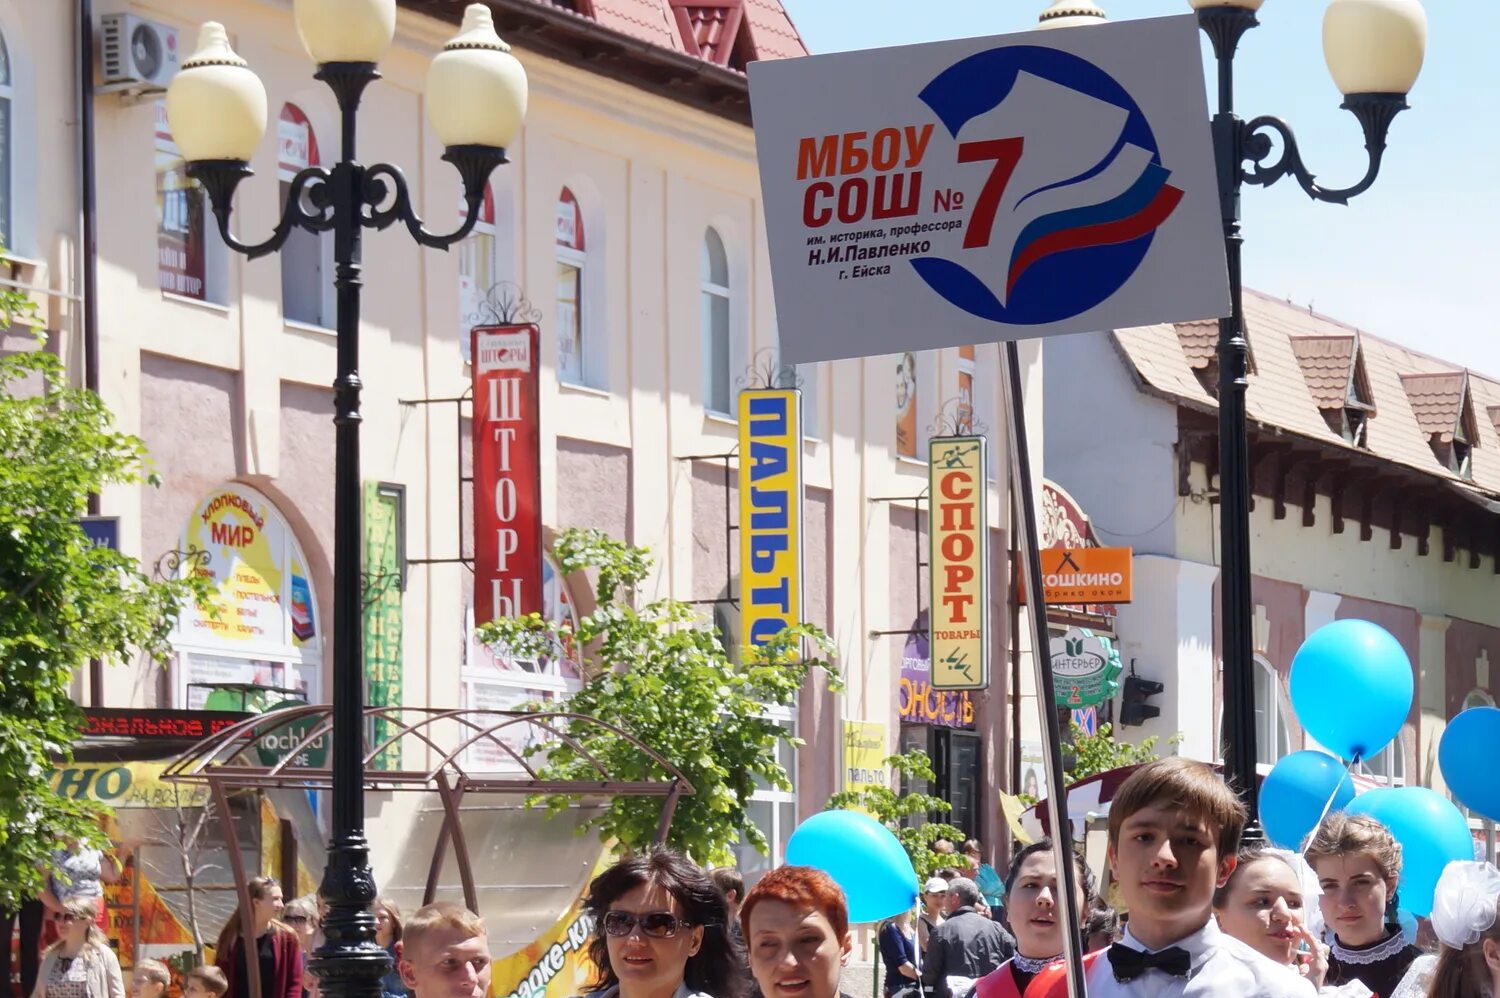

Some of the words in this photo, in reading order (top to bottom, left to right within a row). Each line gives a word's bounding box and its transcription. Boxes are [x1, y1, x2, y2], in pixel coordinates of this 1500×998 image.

[796, 124, 935, 180] МБОУ
[803, 171, 922, 228] СОШ
[933, 188, 964, 213] №
[957, 136, 1025, 249] 7
[806, 236, 827, 246] им.
[830, 228, 887, 244] историка,
[890, 219, 963, 237] профессора
[808, 240, 931, 266] Н.И.Павленко
[838, 270, 848, 280] г.
[852, 264, 891, 279] Ейска
[487, 378, 523, 621] ШТОРЫ
[211, 522, 254, 548] МИР
[749, 397, 789, 653] ПАЛЬТО
[940, 471, 975, 624] СПОРТ
[934, 629, 982, 641] ТОВАРЫ
